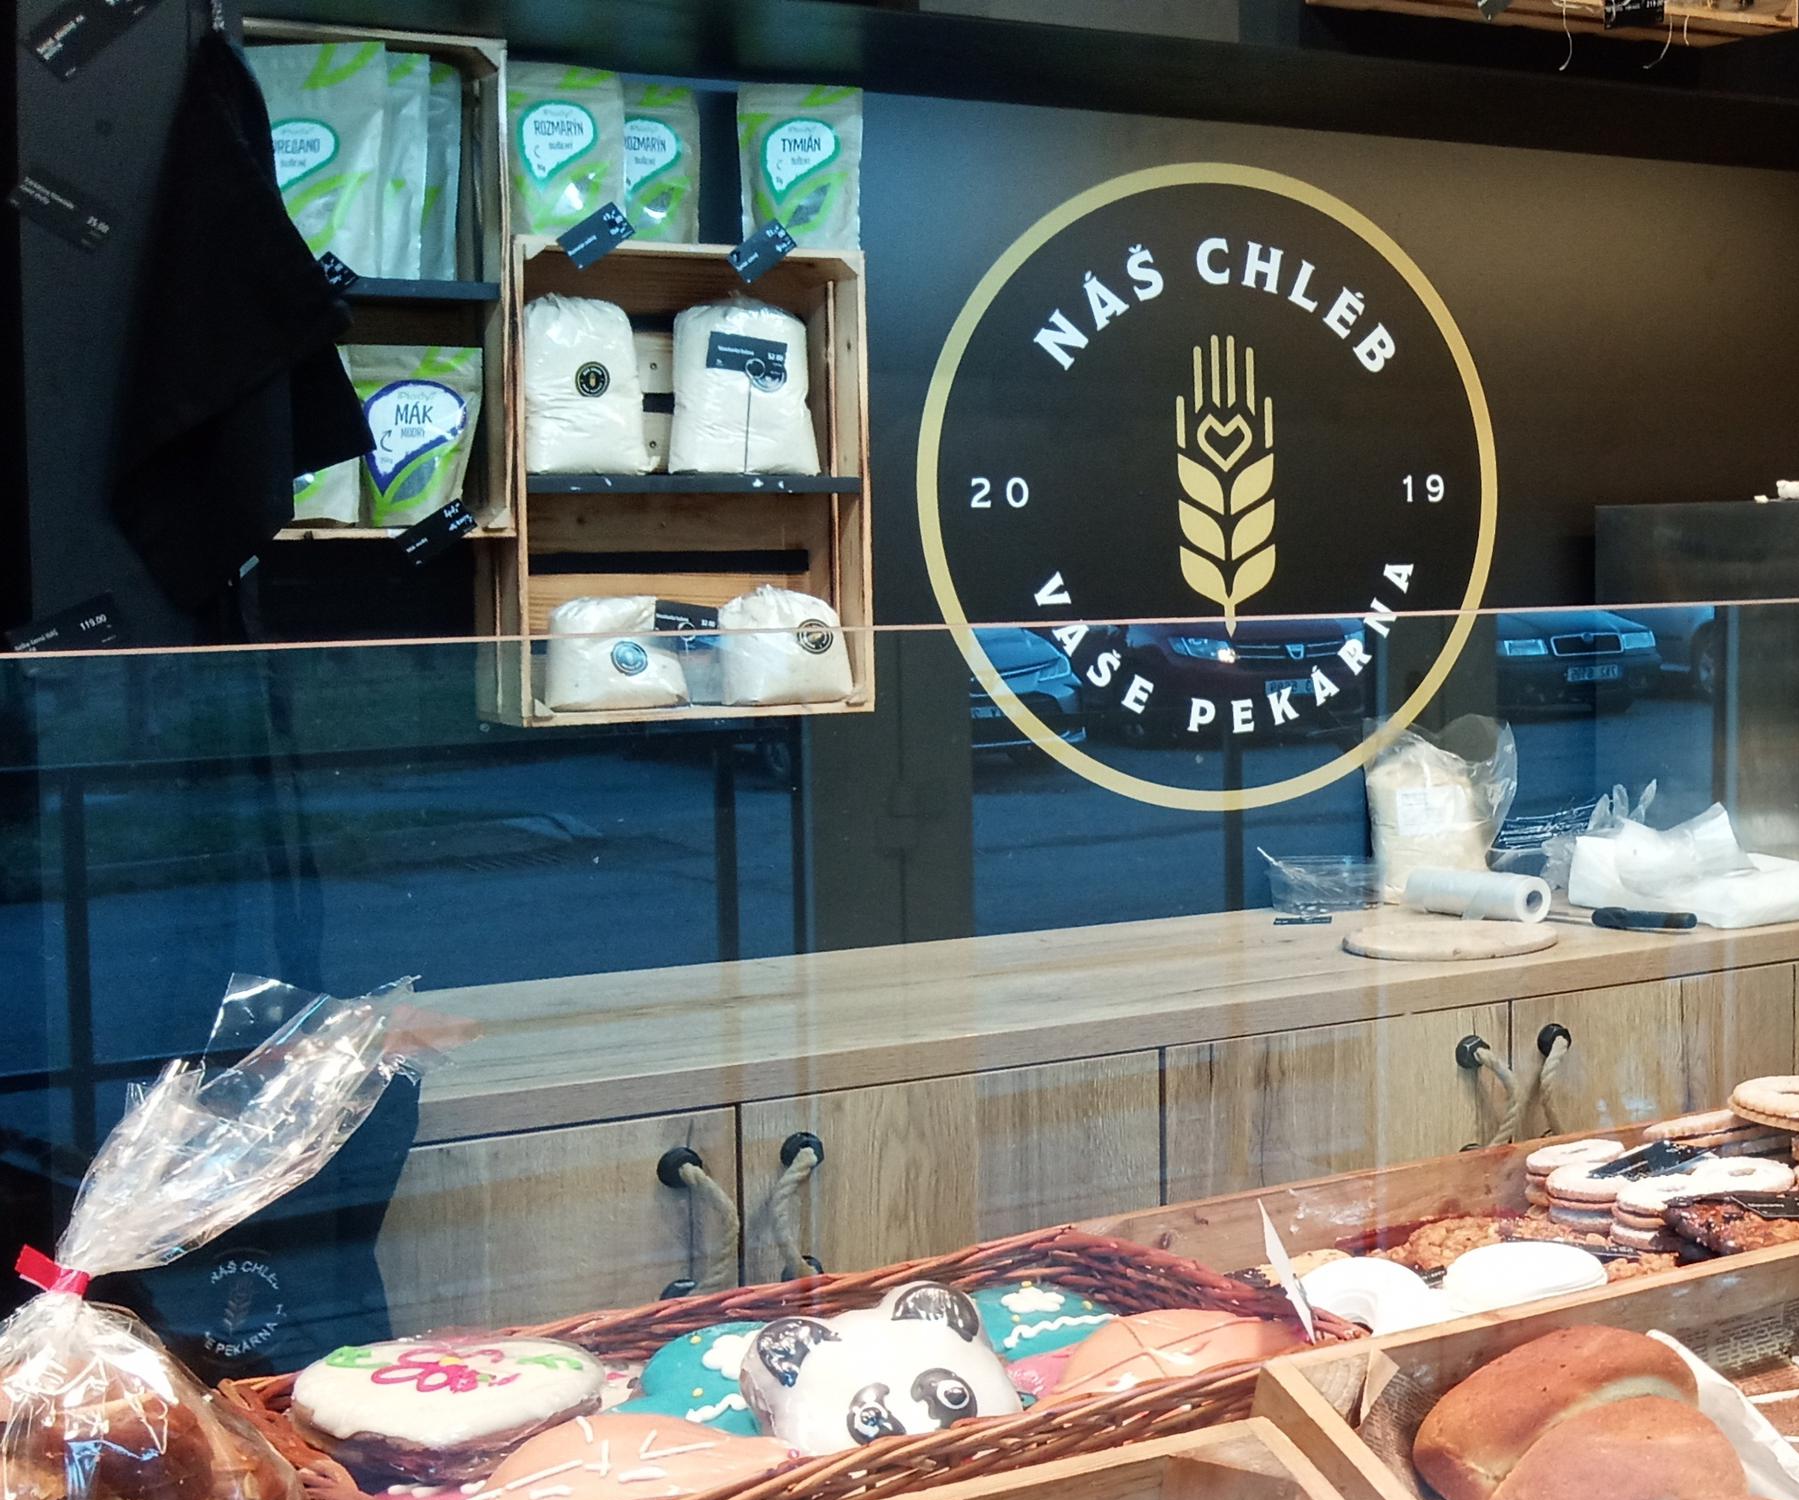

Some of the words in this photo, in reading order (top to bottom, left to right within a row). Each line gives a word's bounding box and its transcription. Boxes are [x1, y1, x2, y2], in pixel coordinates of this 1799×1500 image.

[534, 119, 584, 136] ROZMARÝN
[275, 138, 320, 154] REGANO
[781, 135, 821, 152] TYMIÁN
[1033, 245, 1164, 371] NÁŠ
[1196, 237, 1398, 374] CHLÉB
[394, 401, 434, 425] MÁK
[970, 477, 1030, 510] 20
[1402, 473, 1445, 503] 19
[1033, 571, 1155, 714] VAŠE
[1187, 561, 1414, 734] PEKÁRNA
